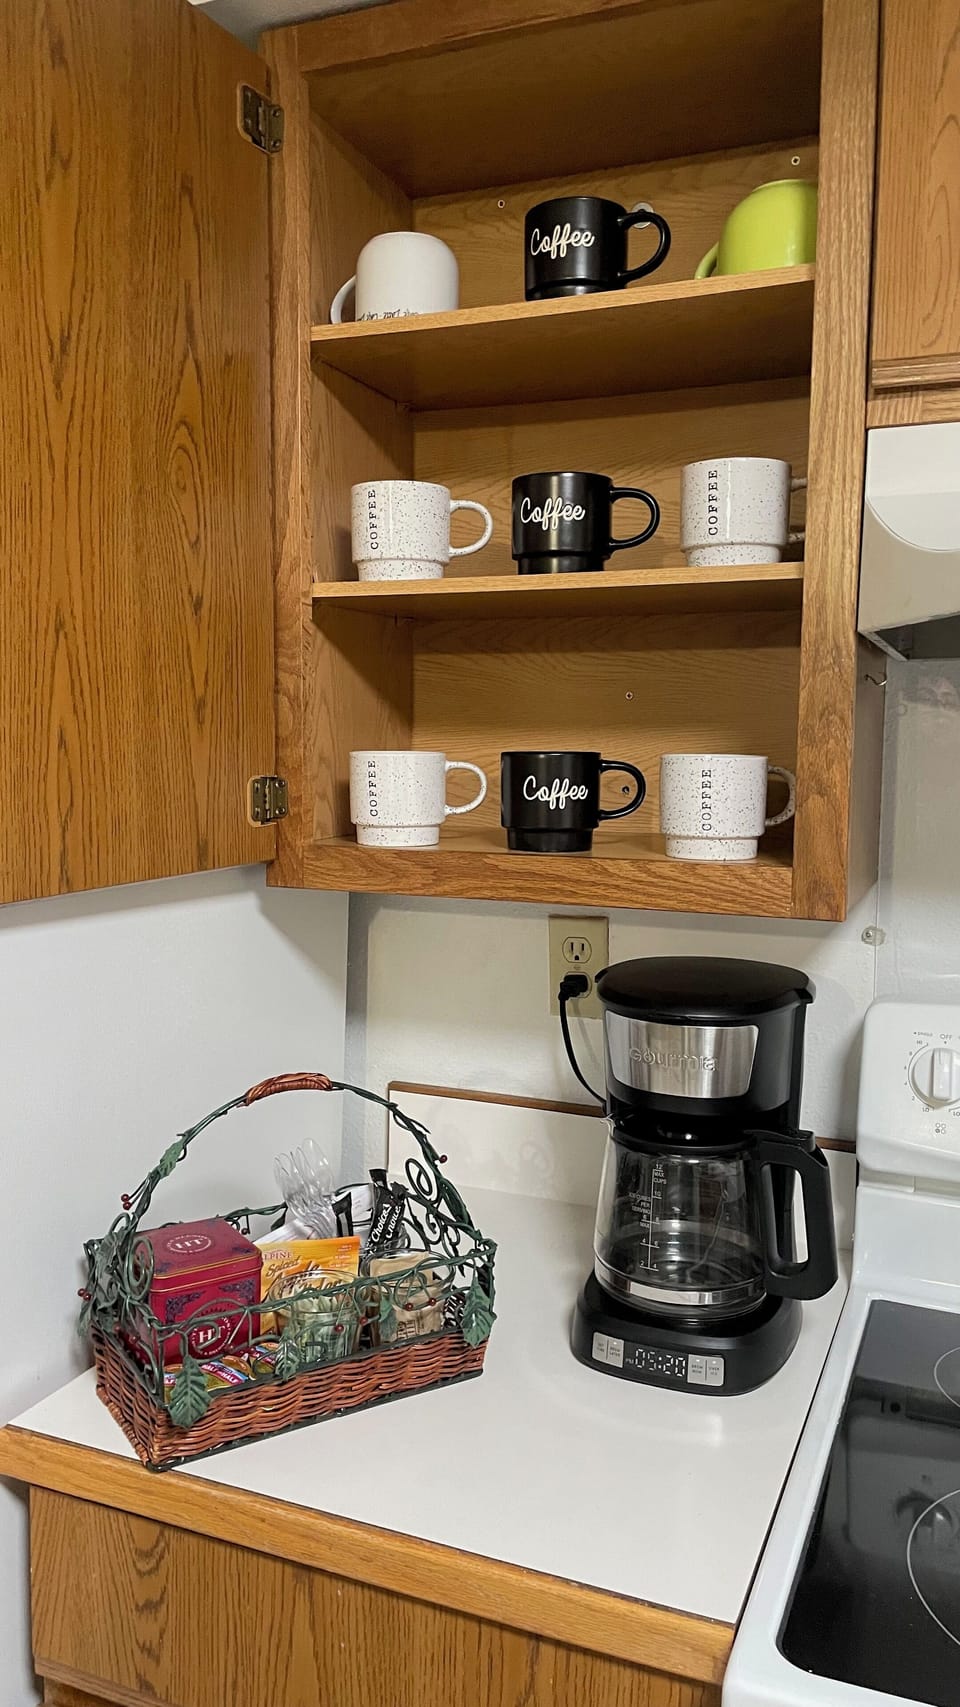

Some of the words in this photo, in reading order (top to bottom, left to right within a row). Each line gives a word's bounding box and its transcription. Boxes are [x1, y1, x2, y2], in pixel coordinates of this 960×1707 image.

[530, 222, 595, 260] Coffee
[367, 489, 379, 550] COFFEE
[520, 497, 586, 531] Coffee
[707, 470, 718, 536] COFFEE
[367, 760, 378, 817] COFFEE
[523, 775, 588, 810] Coffee
[701, 769, 712, 831] COFFEE
